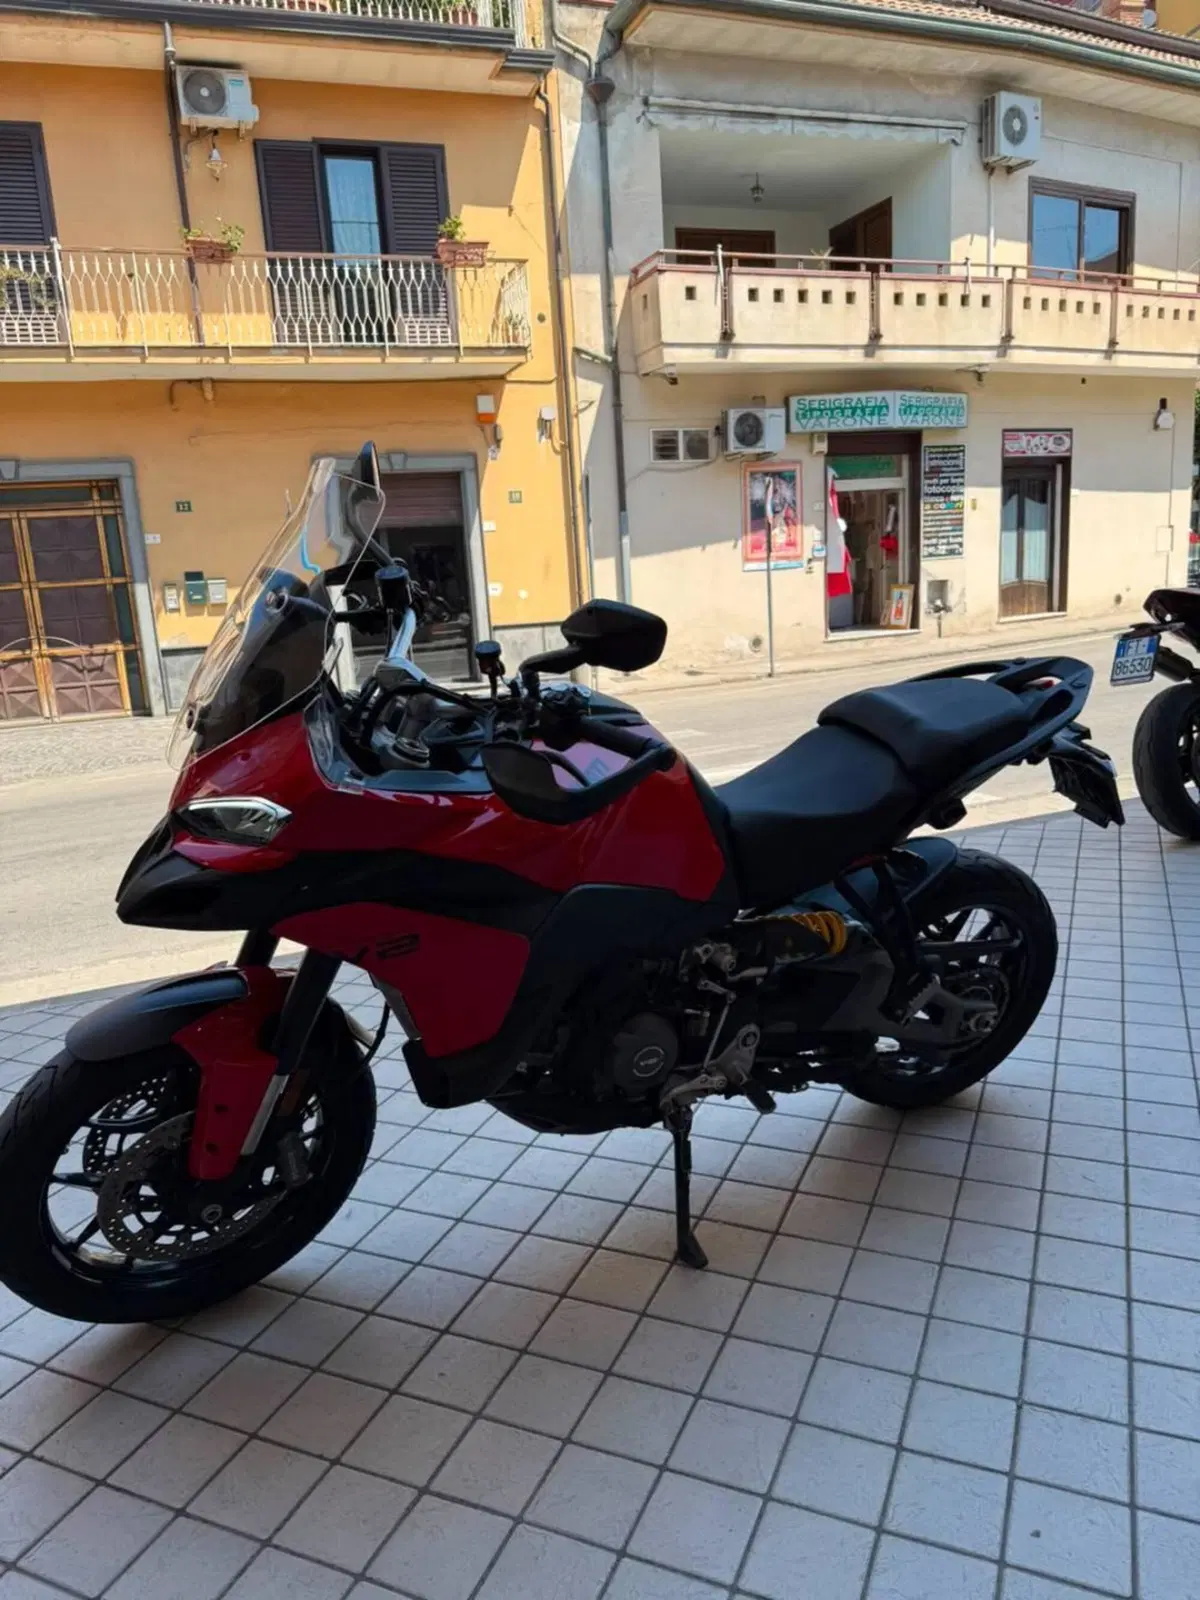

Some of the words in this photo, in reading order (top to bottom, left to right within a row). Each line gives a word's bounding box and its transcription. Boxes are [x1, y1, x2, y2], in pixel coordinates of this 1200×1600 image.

[796, 396, 889, 411] SERIGRAFIA
[899, 394, 965, 407] SERIGRAFIA
[797, 414, 889, 430] VARONE
[900, 414, 965, 426] VARONE
